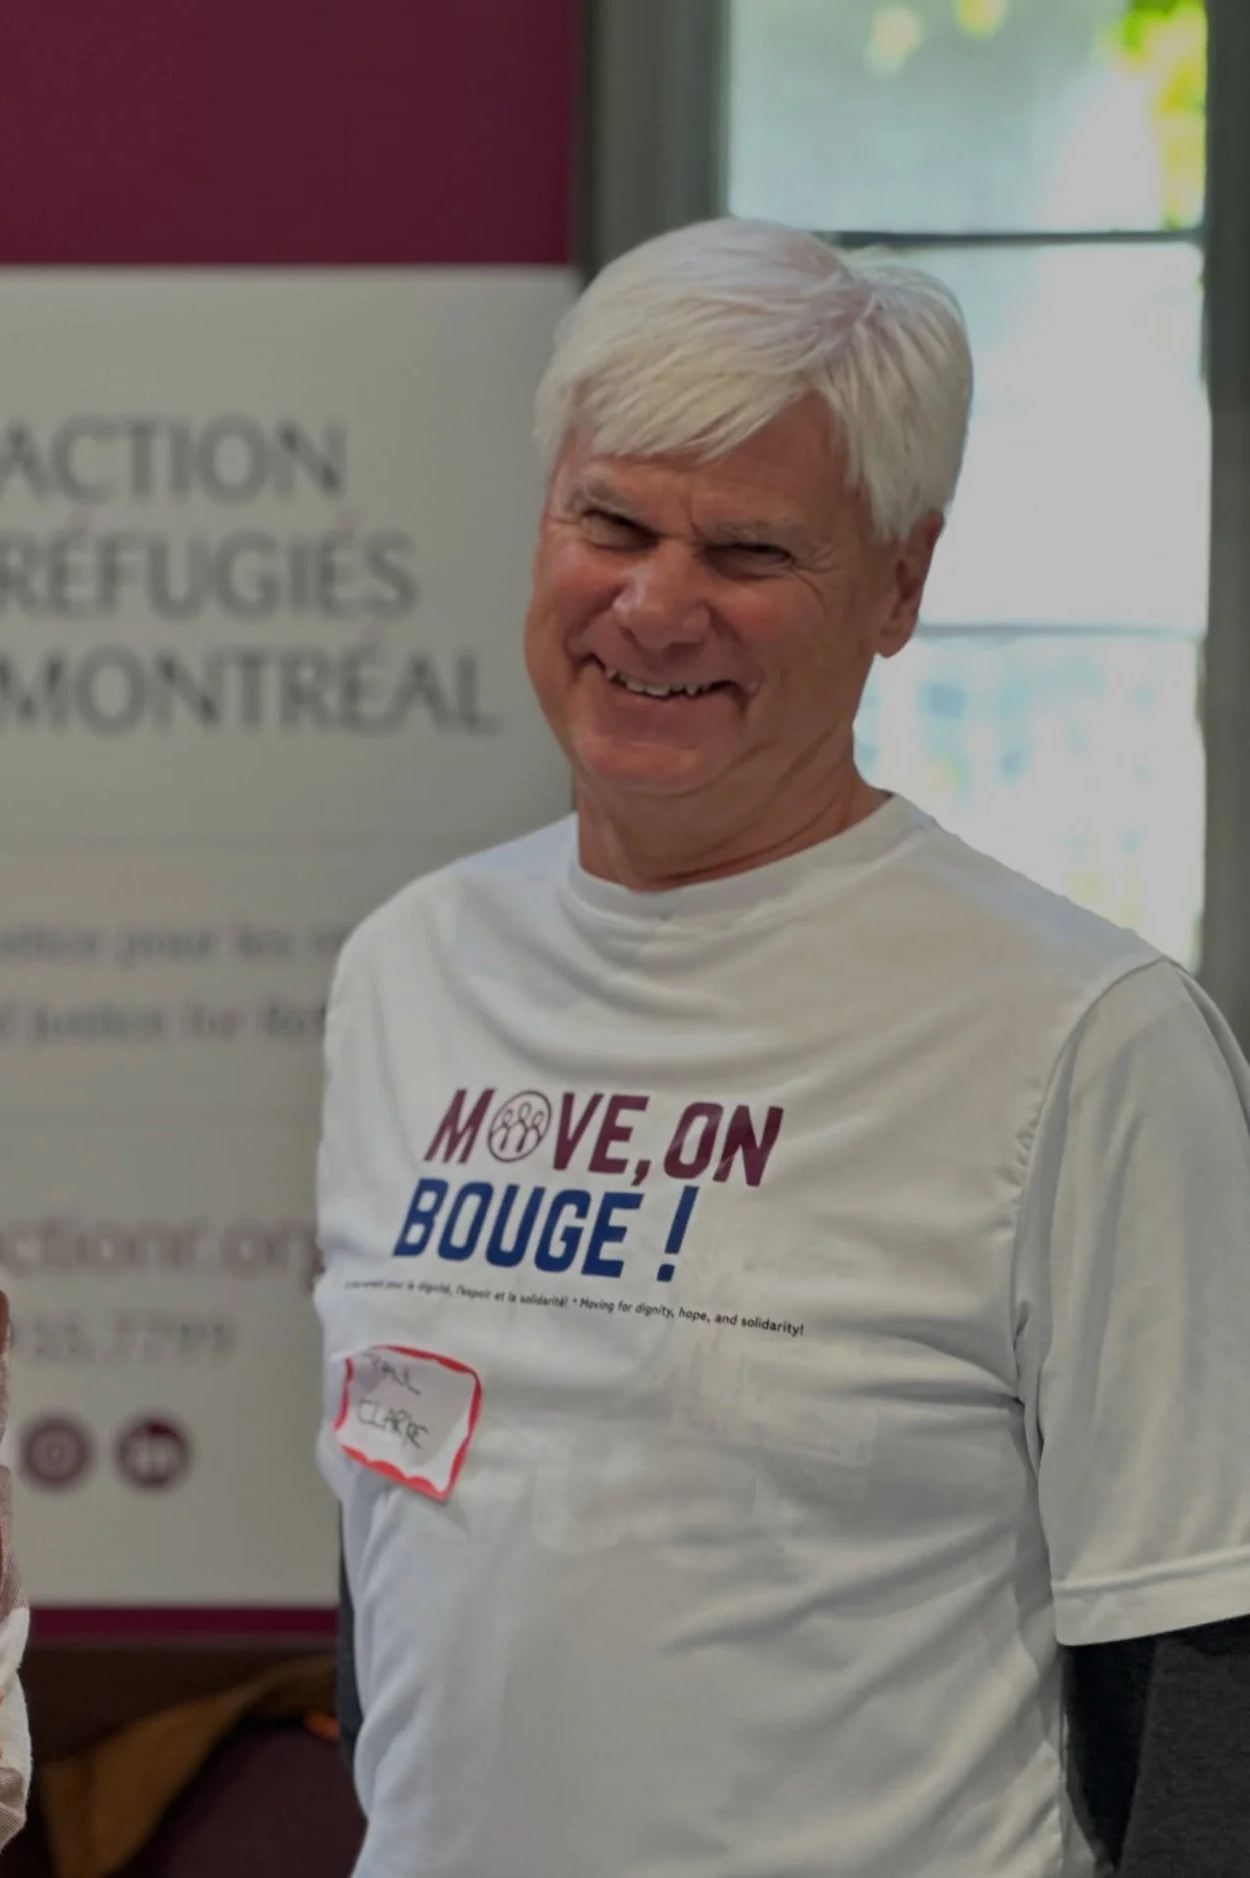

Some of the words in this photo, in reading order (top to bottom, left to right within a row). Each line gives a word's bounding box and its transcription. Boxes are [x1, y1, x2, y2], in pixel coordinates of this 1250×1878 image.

[392, 1178, 644, 1278] BOUGE
[495, 1291, 505, 1302] et
[508, 1291, 517, 1303] la
[579, 1298, 614, 1313] Moving
[618, 1299, 632, 1313] for
[635, 1301, 674, 1318] dignity,
[678, 1306, 711, 1324] hope,
[714, 1312, 737, 1326] and
[741, 1316, 805, 1337] solidarity!
